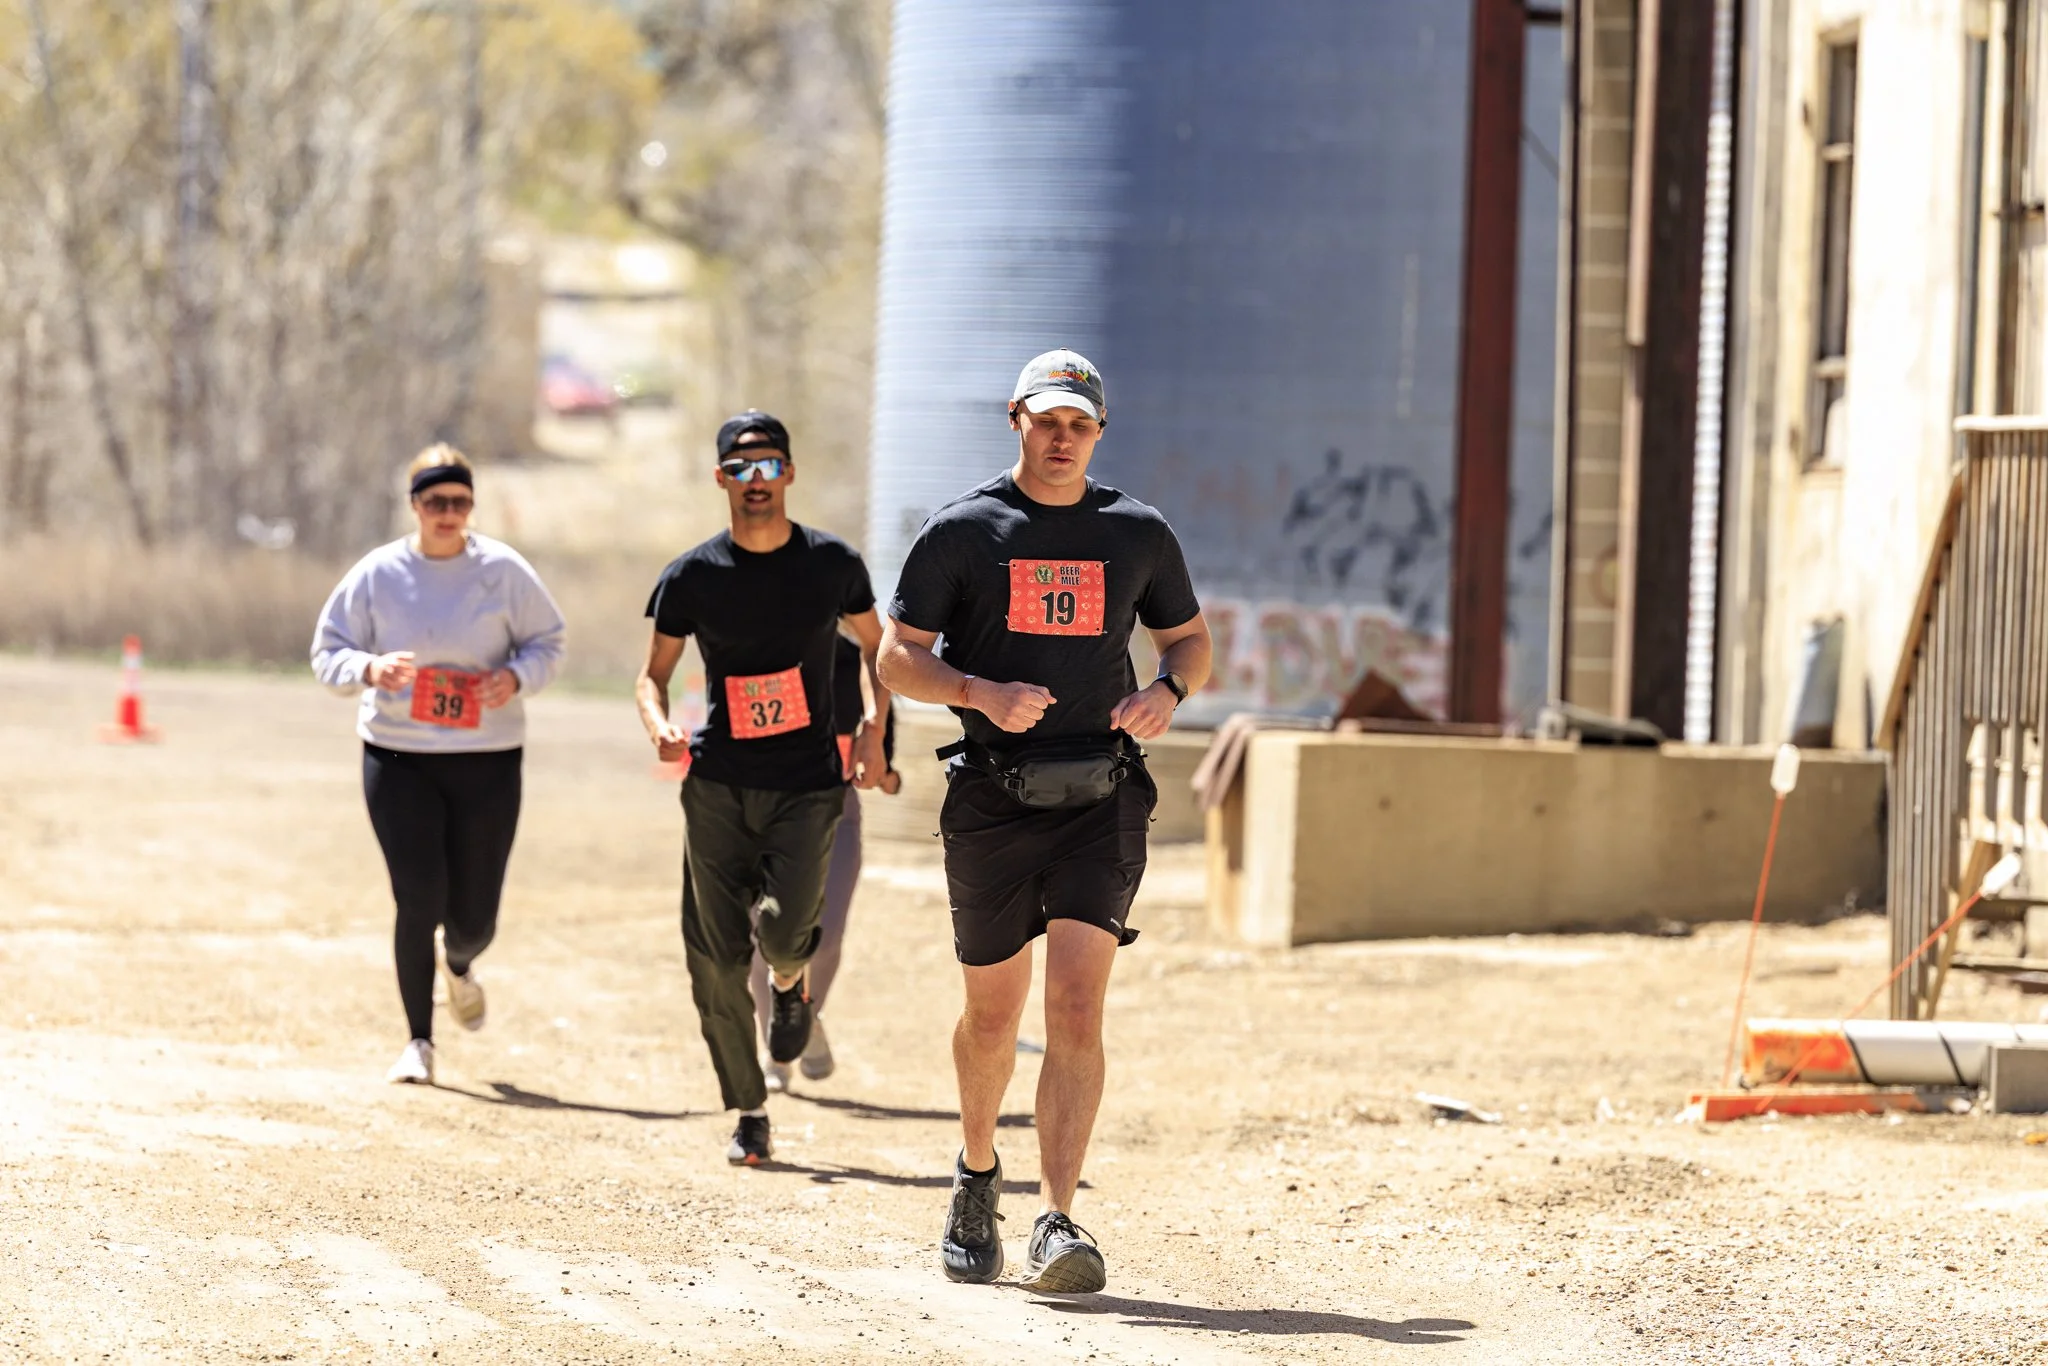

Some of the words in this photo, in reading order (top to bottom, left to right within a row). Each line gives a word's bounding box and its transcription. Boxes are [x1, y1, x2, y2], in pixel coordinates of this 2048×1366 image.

[1059, 566, 1080, 575] BEER
[1061, 576, 1080, 586] MILE
[1041, 591, 1076, 625] 19
[433, 692, 463, 719] 39
[750, 700, 785, 728] 32
